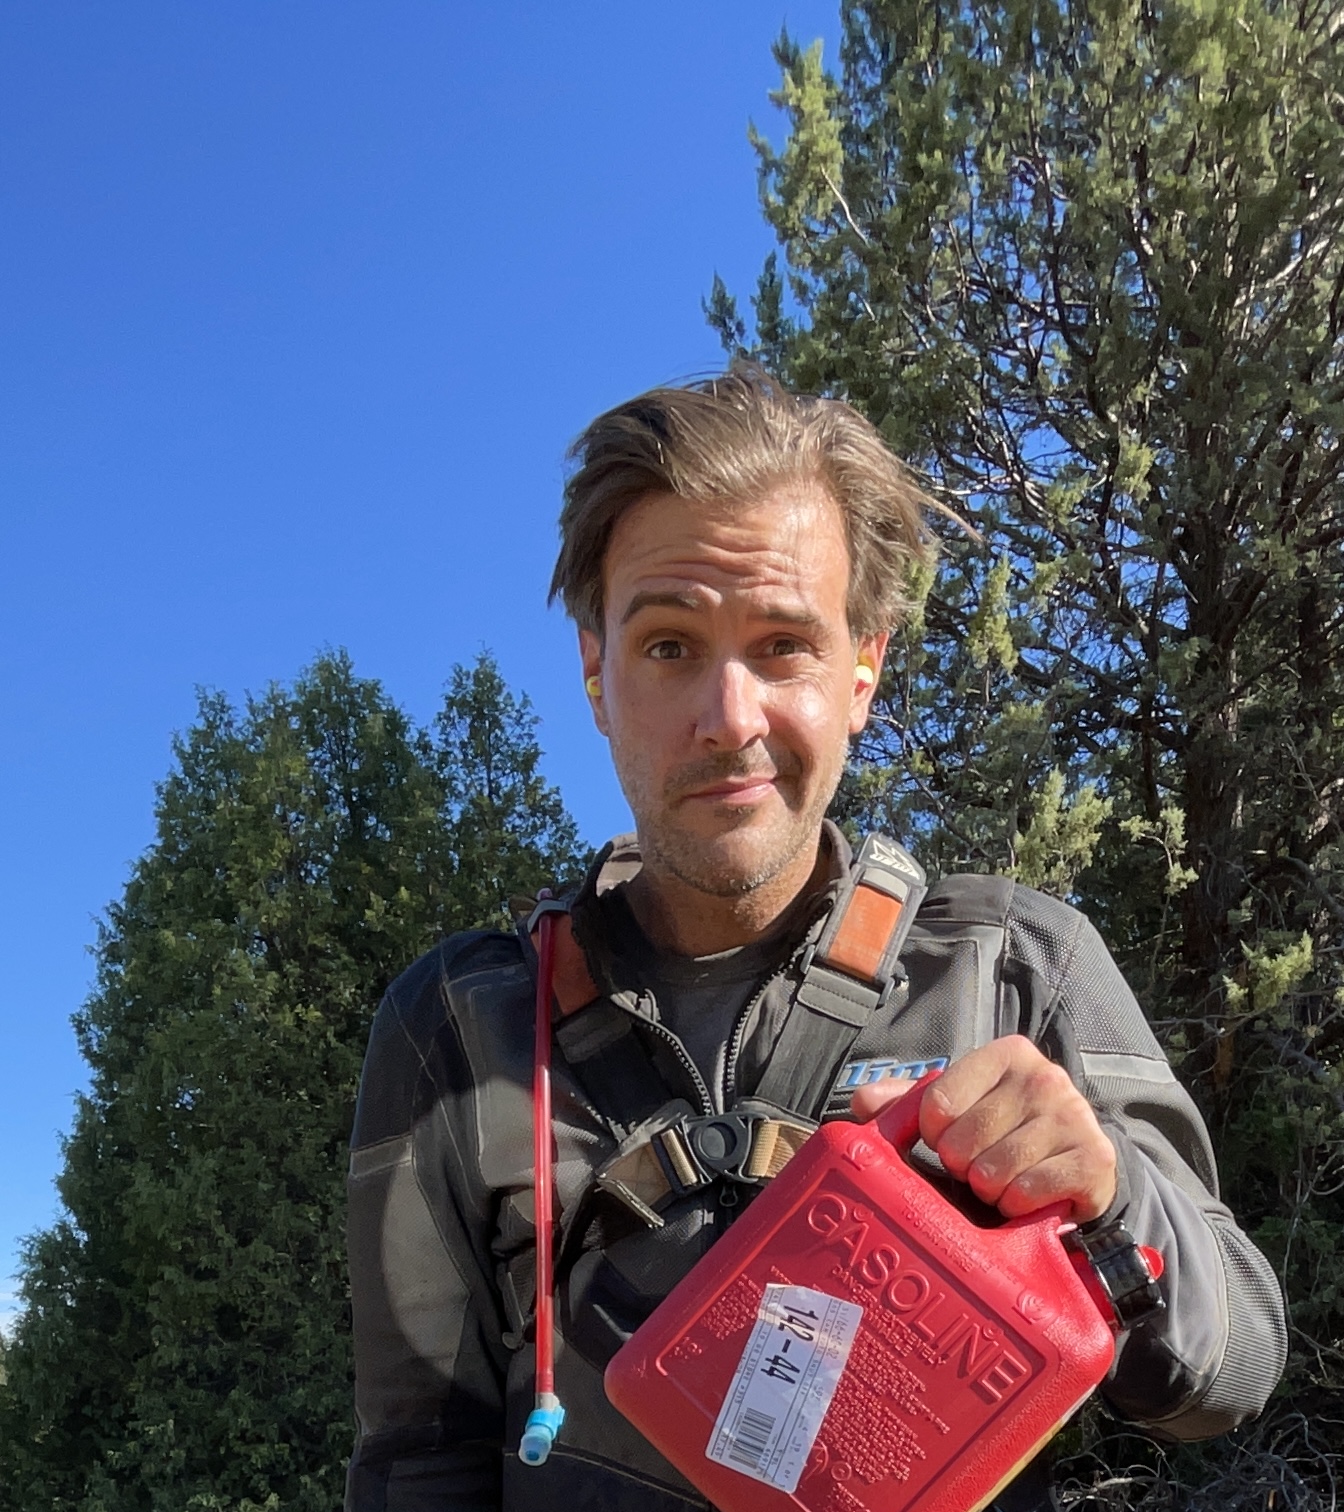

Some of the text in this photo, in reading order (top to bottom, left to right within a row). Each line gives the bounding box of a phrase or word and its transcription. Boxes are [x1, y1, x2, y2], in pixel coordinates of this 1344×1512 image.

[807, 1194, 1027, 1402] GASOLINE
[760, 1306, 818, 1383] 142-44
[880, 1309, 946, 1371] EXTREMELY
